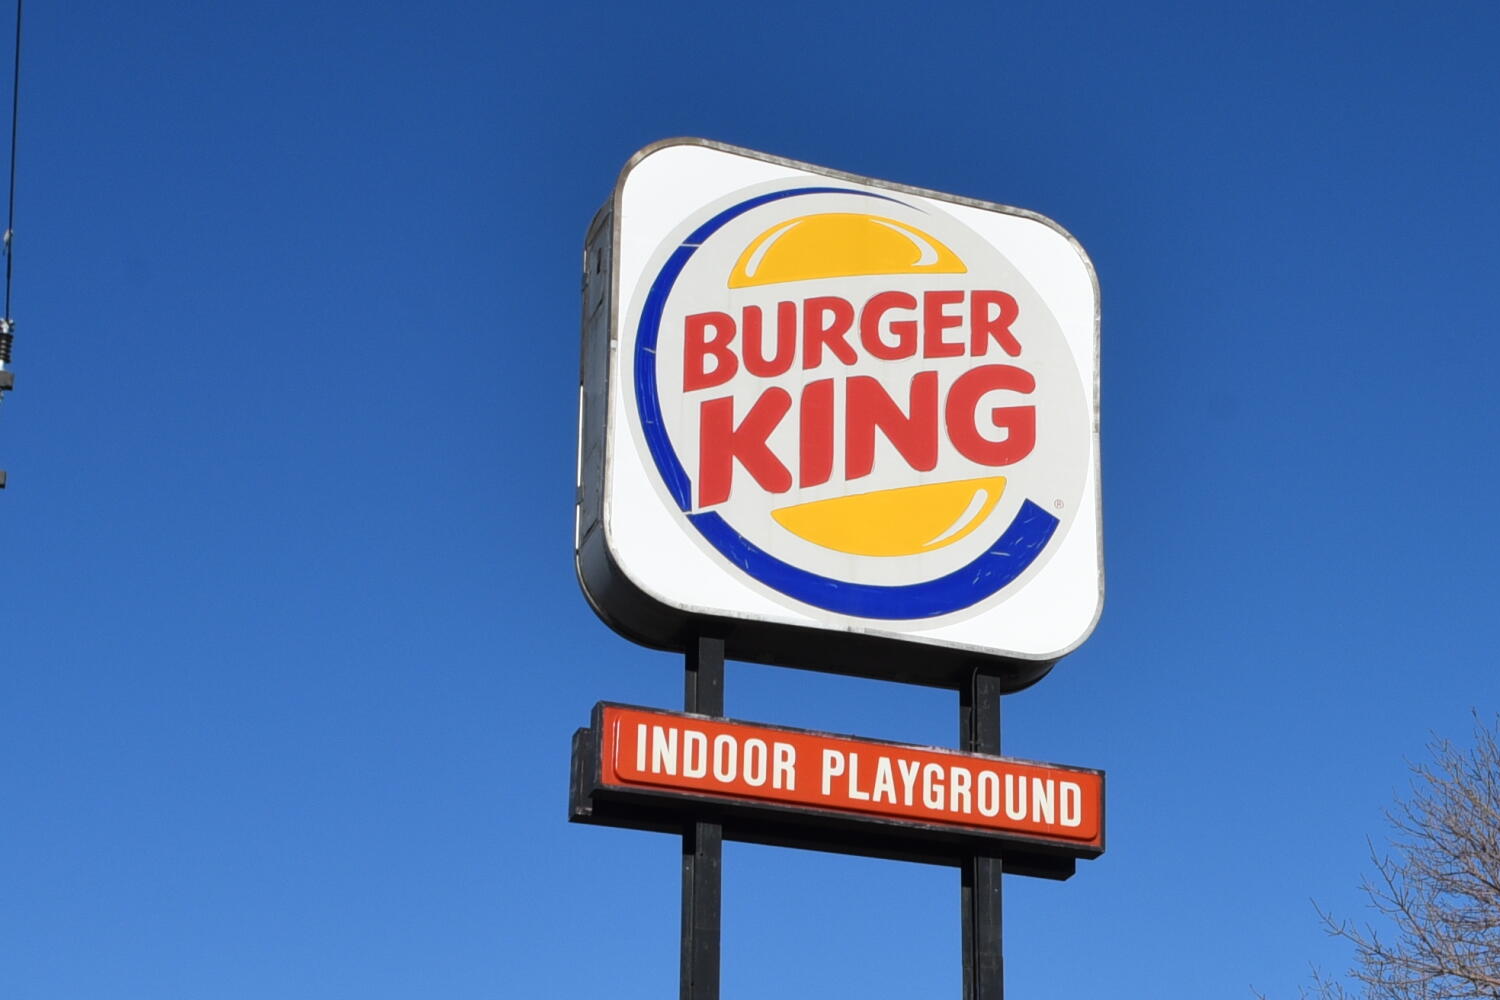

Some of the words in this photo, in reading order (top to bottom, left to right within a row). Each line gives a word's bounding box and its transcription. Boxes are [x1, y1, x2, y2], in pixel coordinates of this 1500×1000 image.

[683, 290, 1022, 393] BURGER
[698, 364, 1036, 508] KING
[636, 724, 796, 791] INDOOR
[822, 749, 1082, 827] PLAYGROUND
